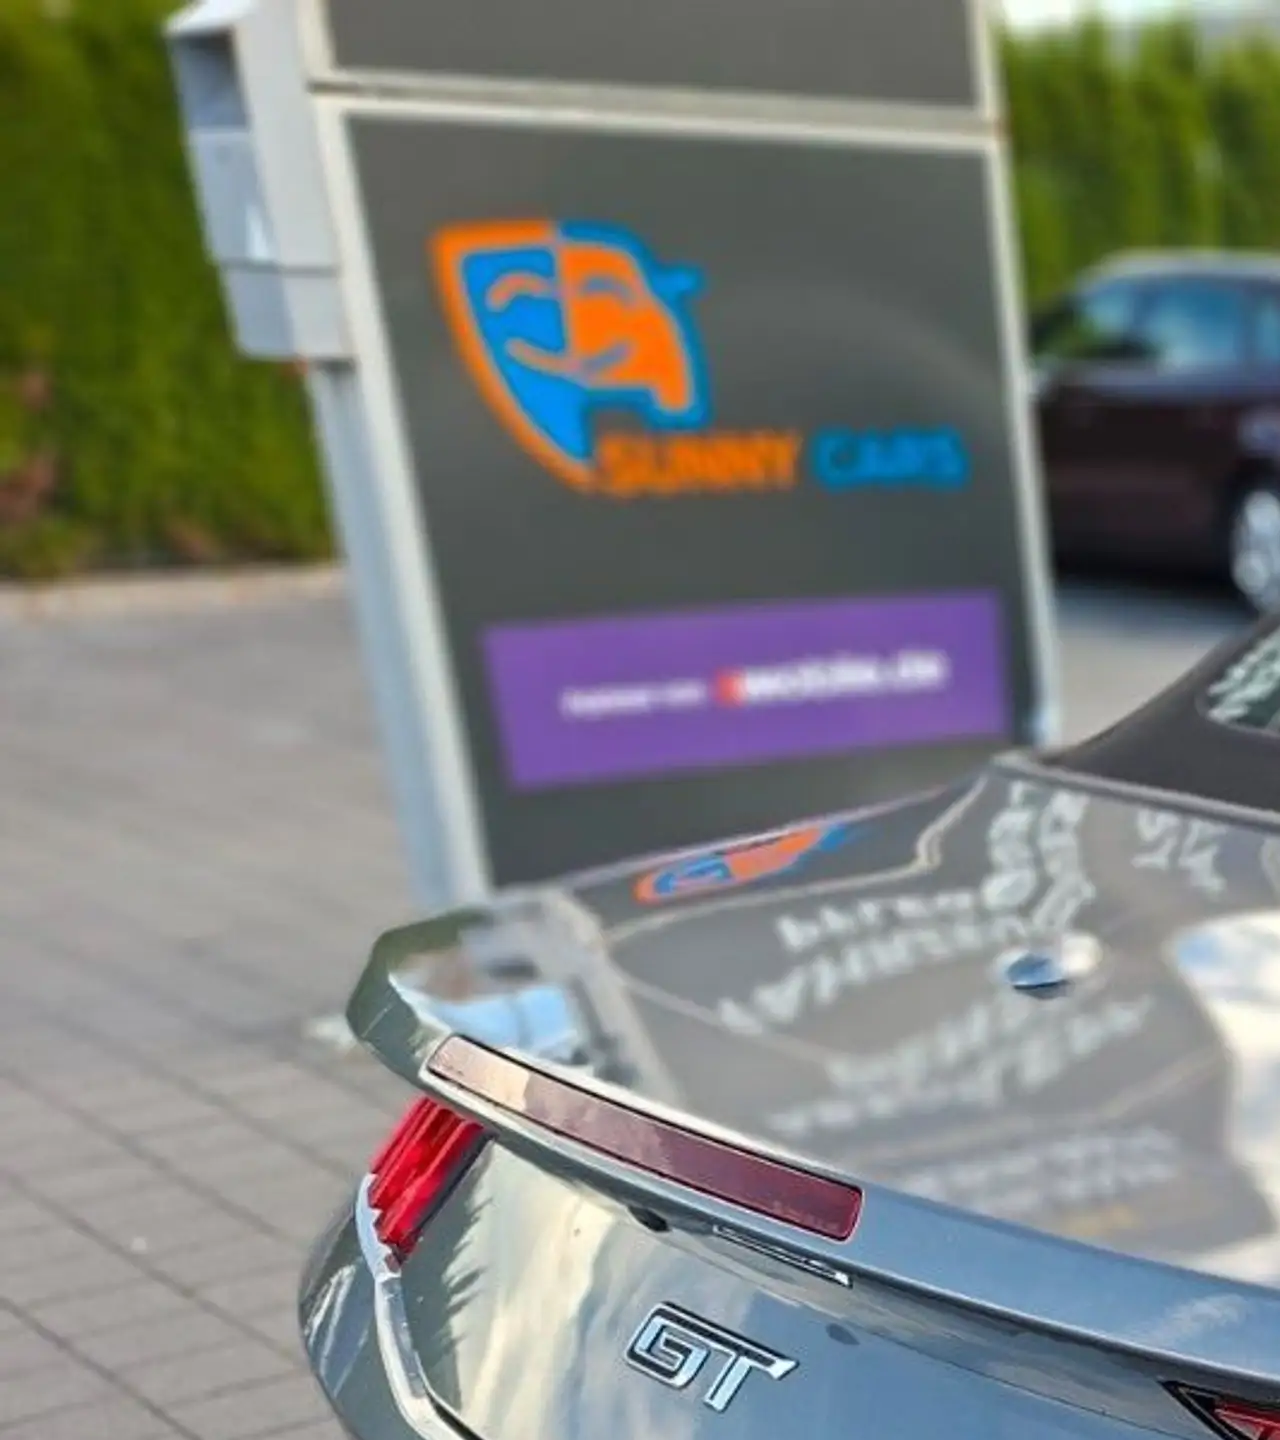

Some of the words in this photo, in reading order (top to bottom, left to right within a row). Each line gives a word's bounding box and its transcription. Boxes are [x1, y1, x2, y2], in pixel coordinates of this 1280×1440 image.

[600, 432, 798, 495] SUNNY
[814, 427, 969, 489] CARS
[626, 1301, 799, 1413] GT
